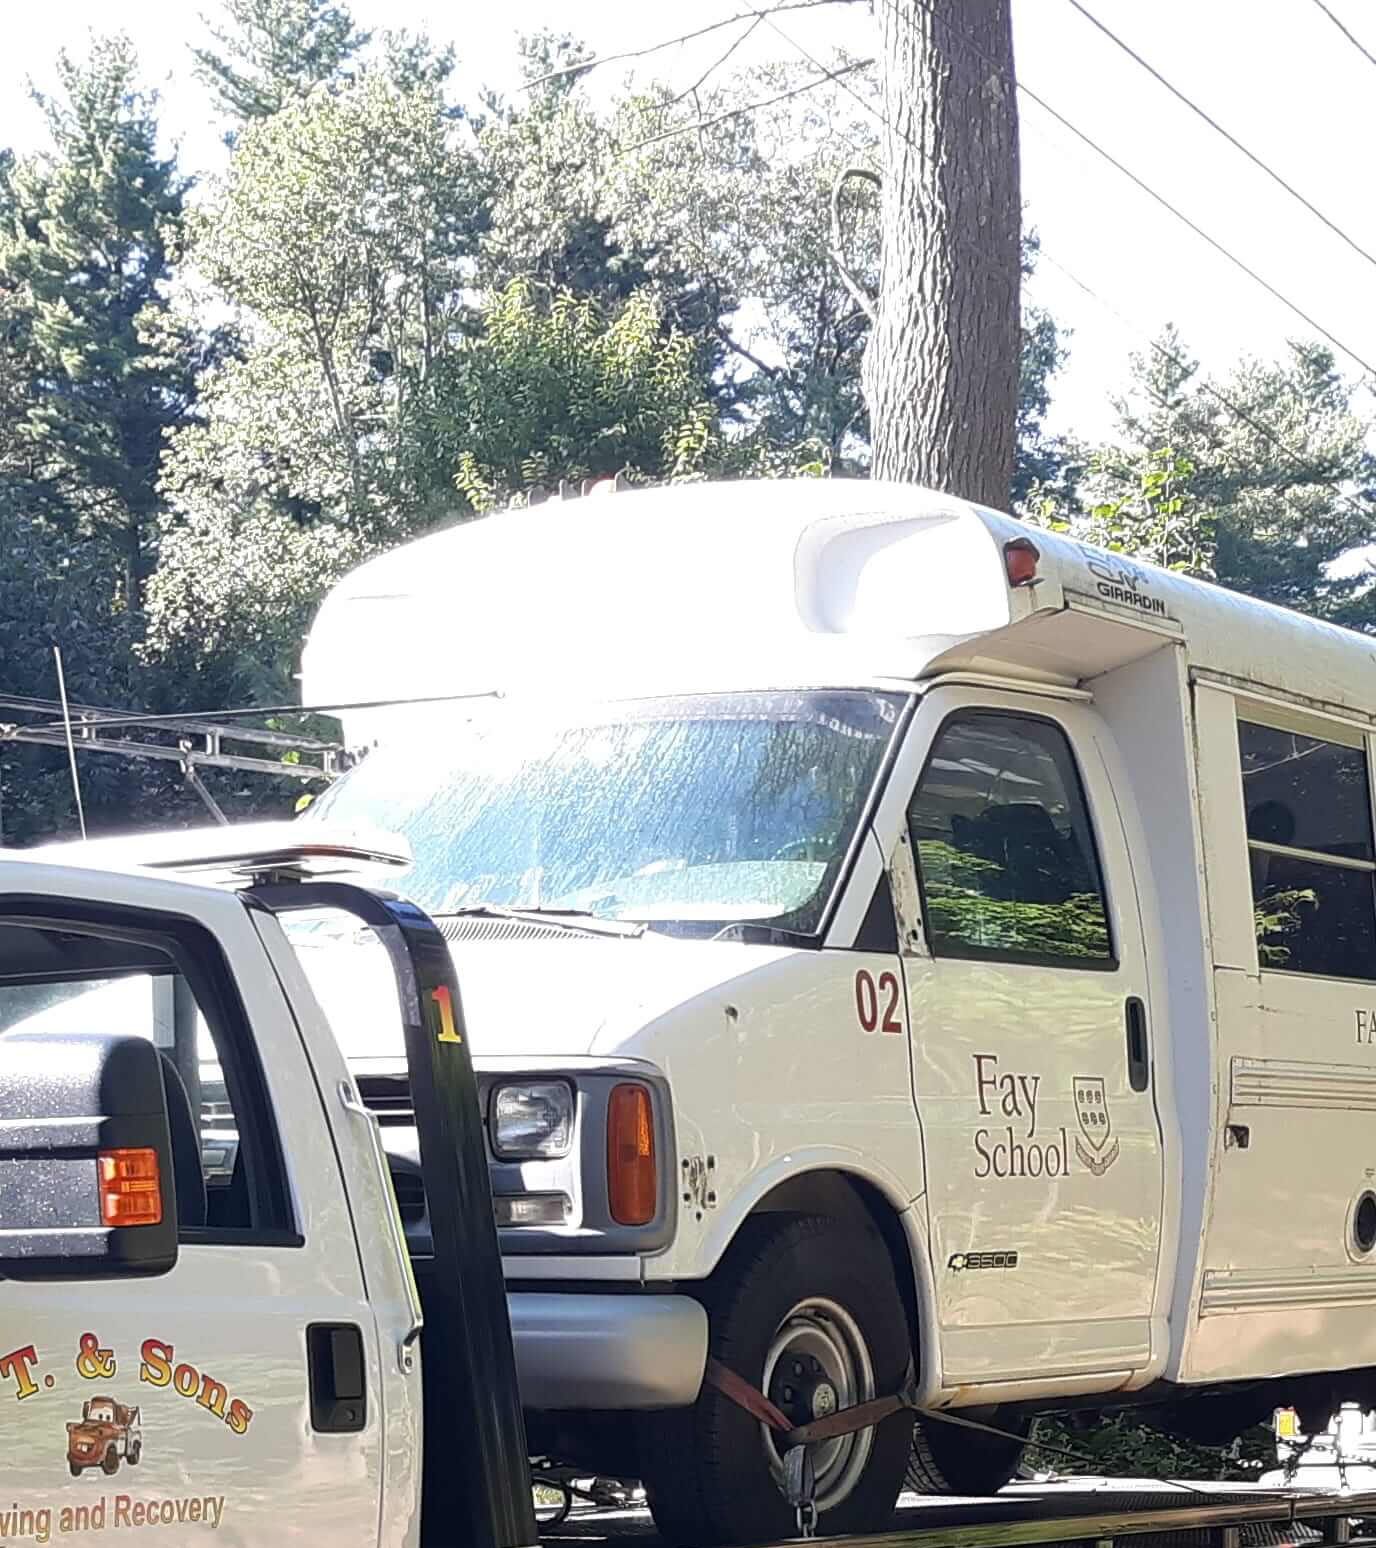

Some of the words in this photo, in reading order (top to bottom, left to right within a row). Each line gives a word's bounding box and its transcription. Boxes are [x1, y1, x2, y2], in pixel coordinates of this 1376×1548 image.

[1096, 582, 1165, 615] GIRARDIN
[432, 985, 461, 1043] 1
[855, 969, 902, 1034] 02
[973, 1054, 1041, 1138] Fay
[974, 1128, 1070, 1177] School
[76, 1332, 117, 1379] &
[140, 1338, 254, 1435] Sons
[59, 1497, 106, 1533] and
[114, 1495, 224, 1528] Recovery
